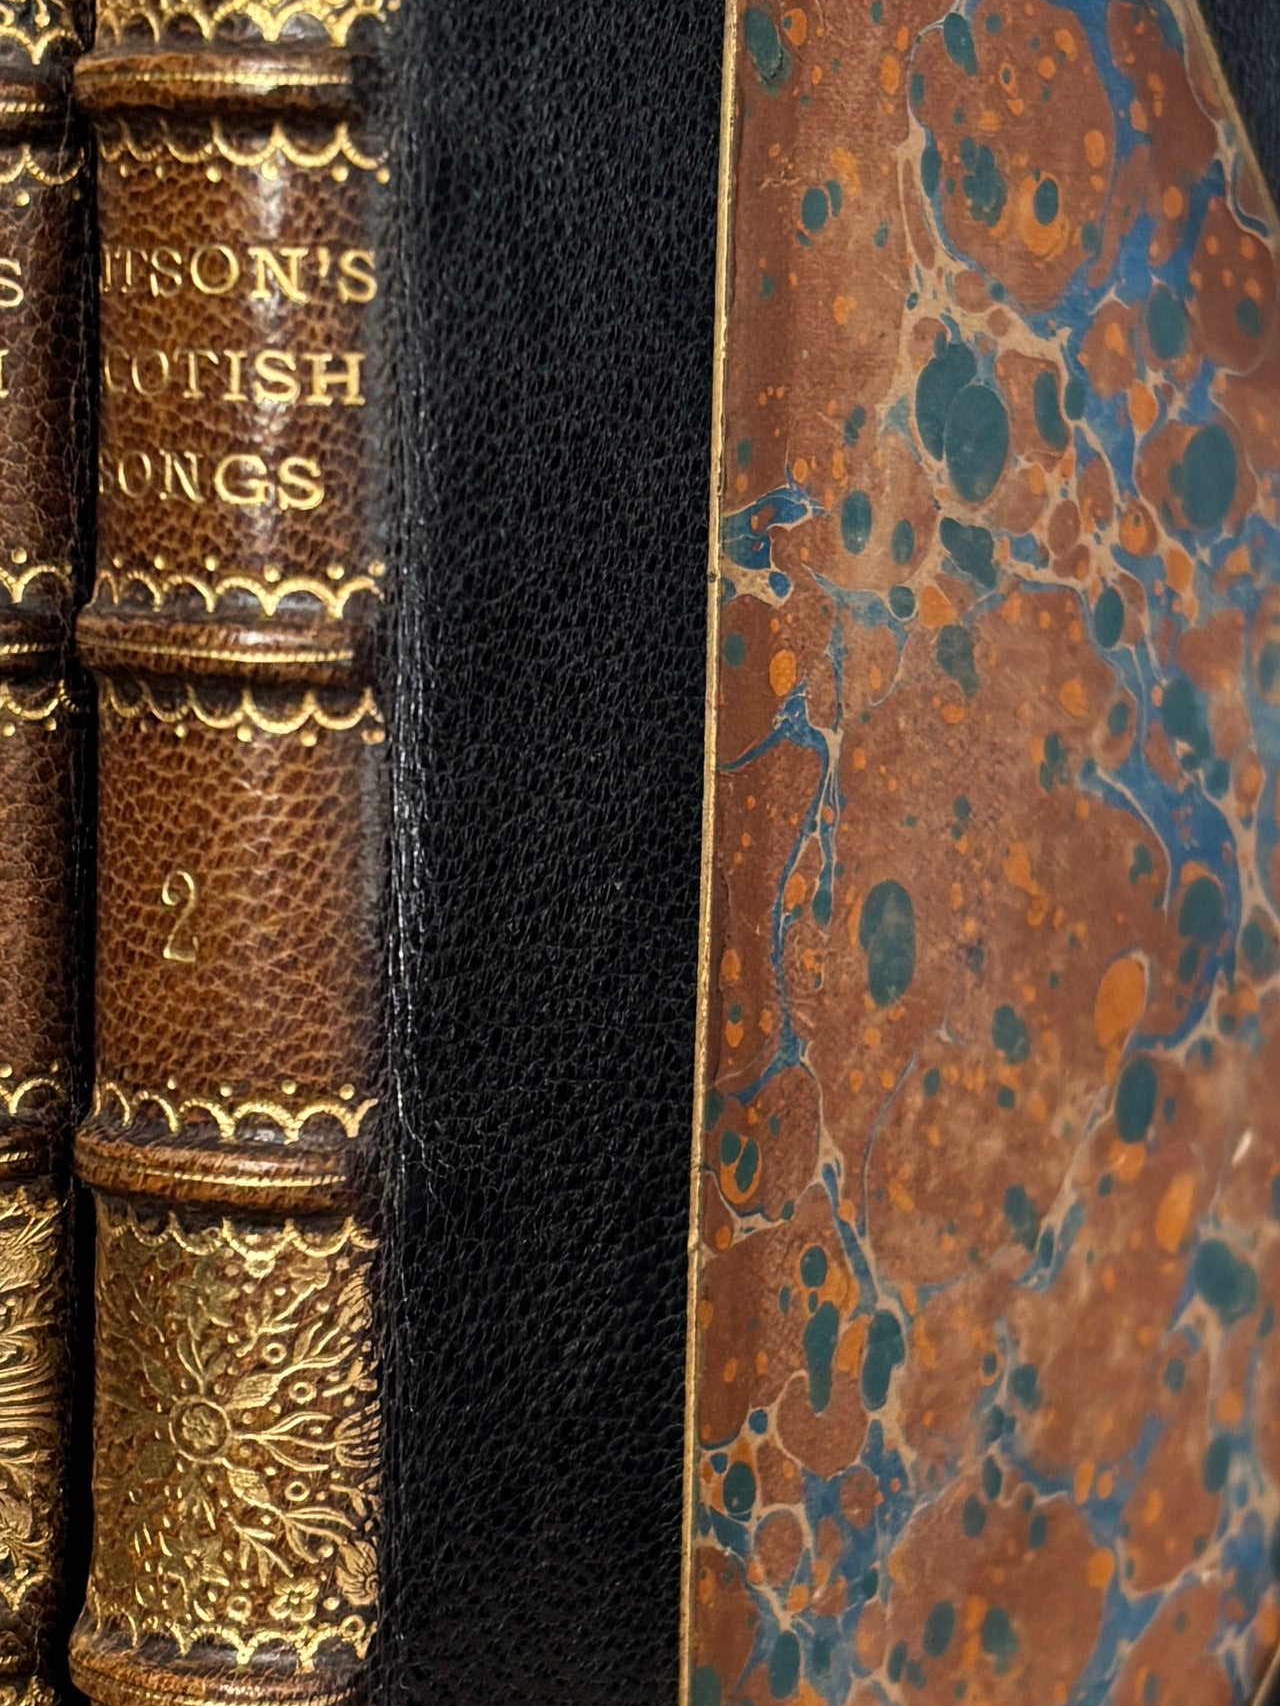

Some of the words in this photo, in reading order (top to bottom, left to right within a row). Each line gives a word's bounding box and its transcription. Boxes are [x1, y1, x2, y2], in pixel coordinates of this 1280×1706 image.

[99, 244, 378, 303] ITSON'S
[104, 346, 366, 406] COTISH
[161, 870, 198, 963] 2
